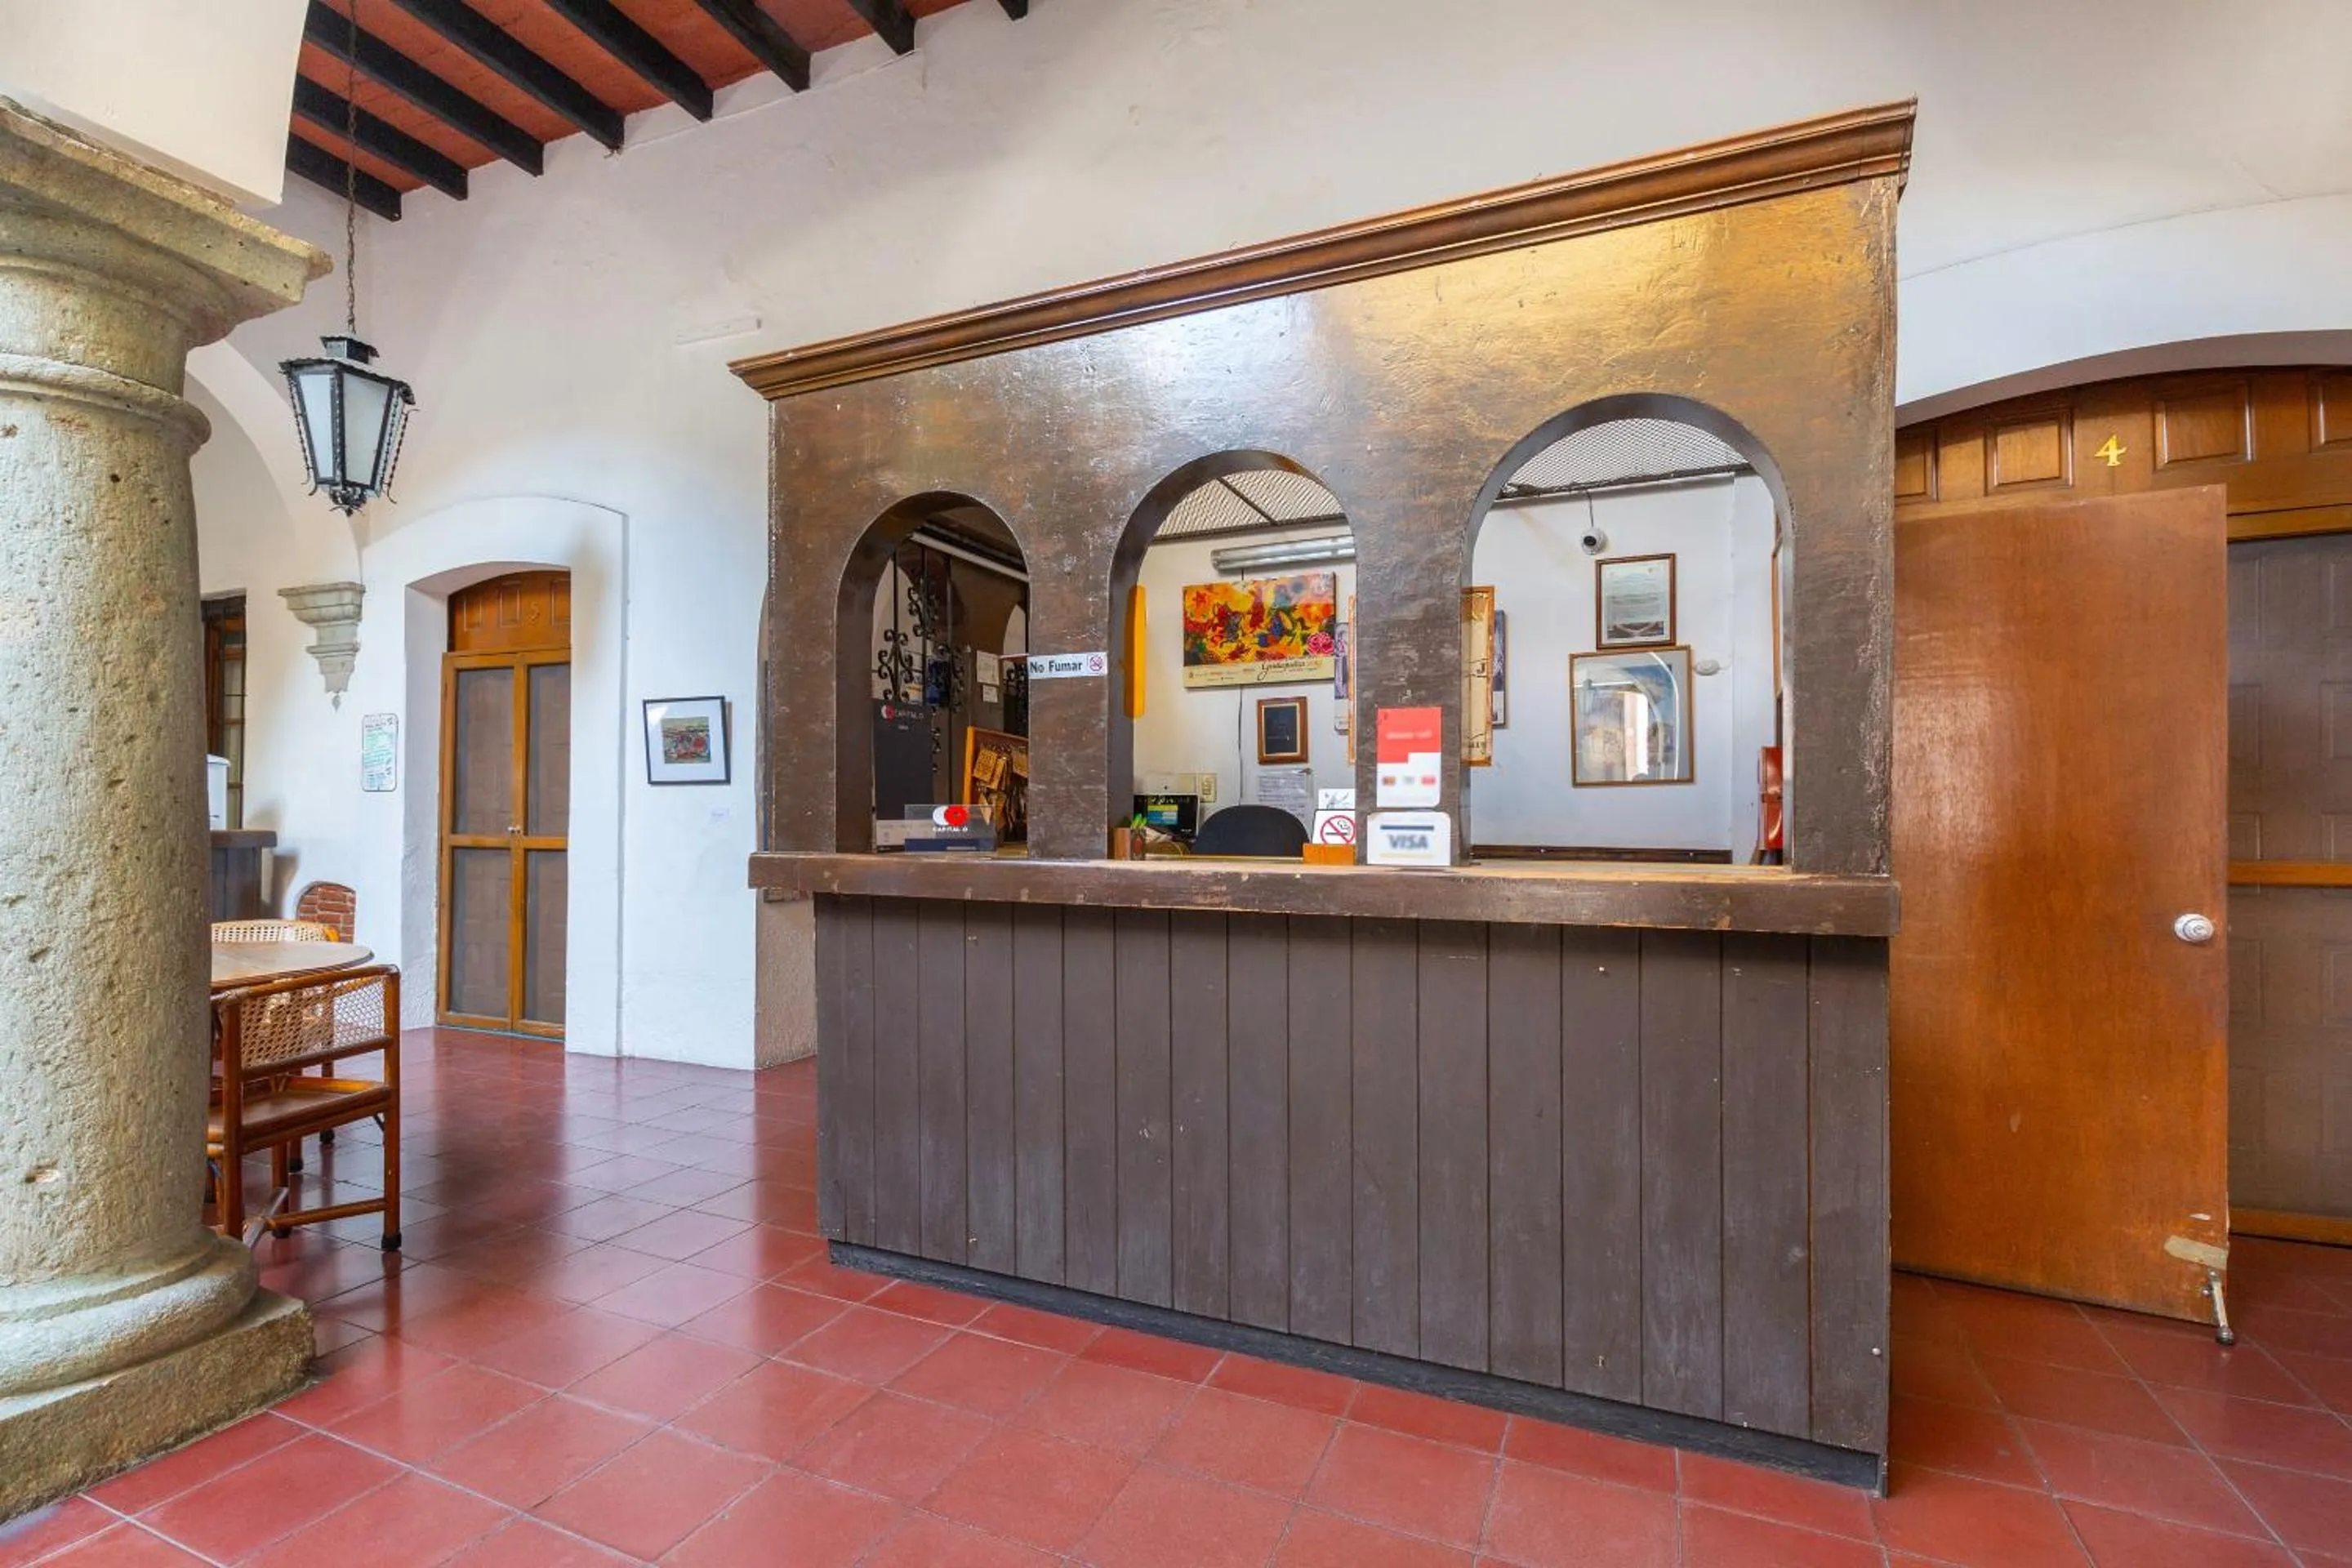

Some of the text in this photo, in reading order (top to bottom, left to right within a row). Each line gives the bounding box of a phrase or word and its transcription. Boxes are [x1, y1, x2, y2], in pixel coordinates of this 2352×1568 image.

[2094, 434, 2127, 466] 4
[1030, 660, 1083, 674] No Fumar
[1388, 835, 1428, 850] VISA
